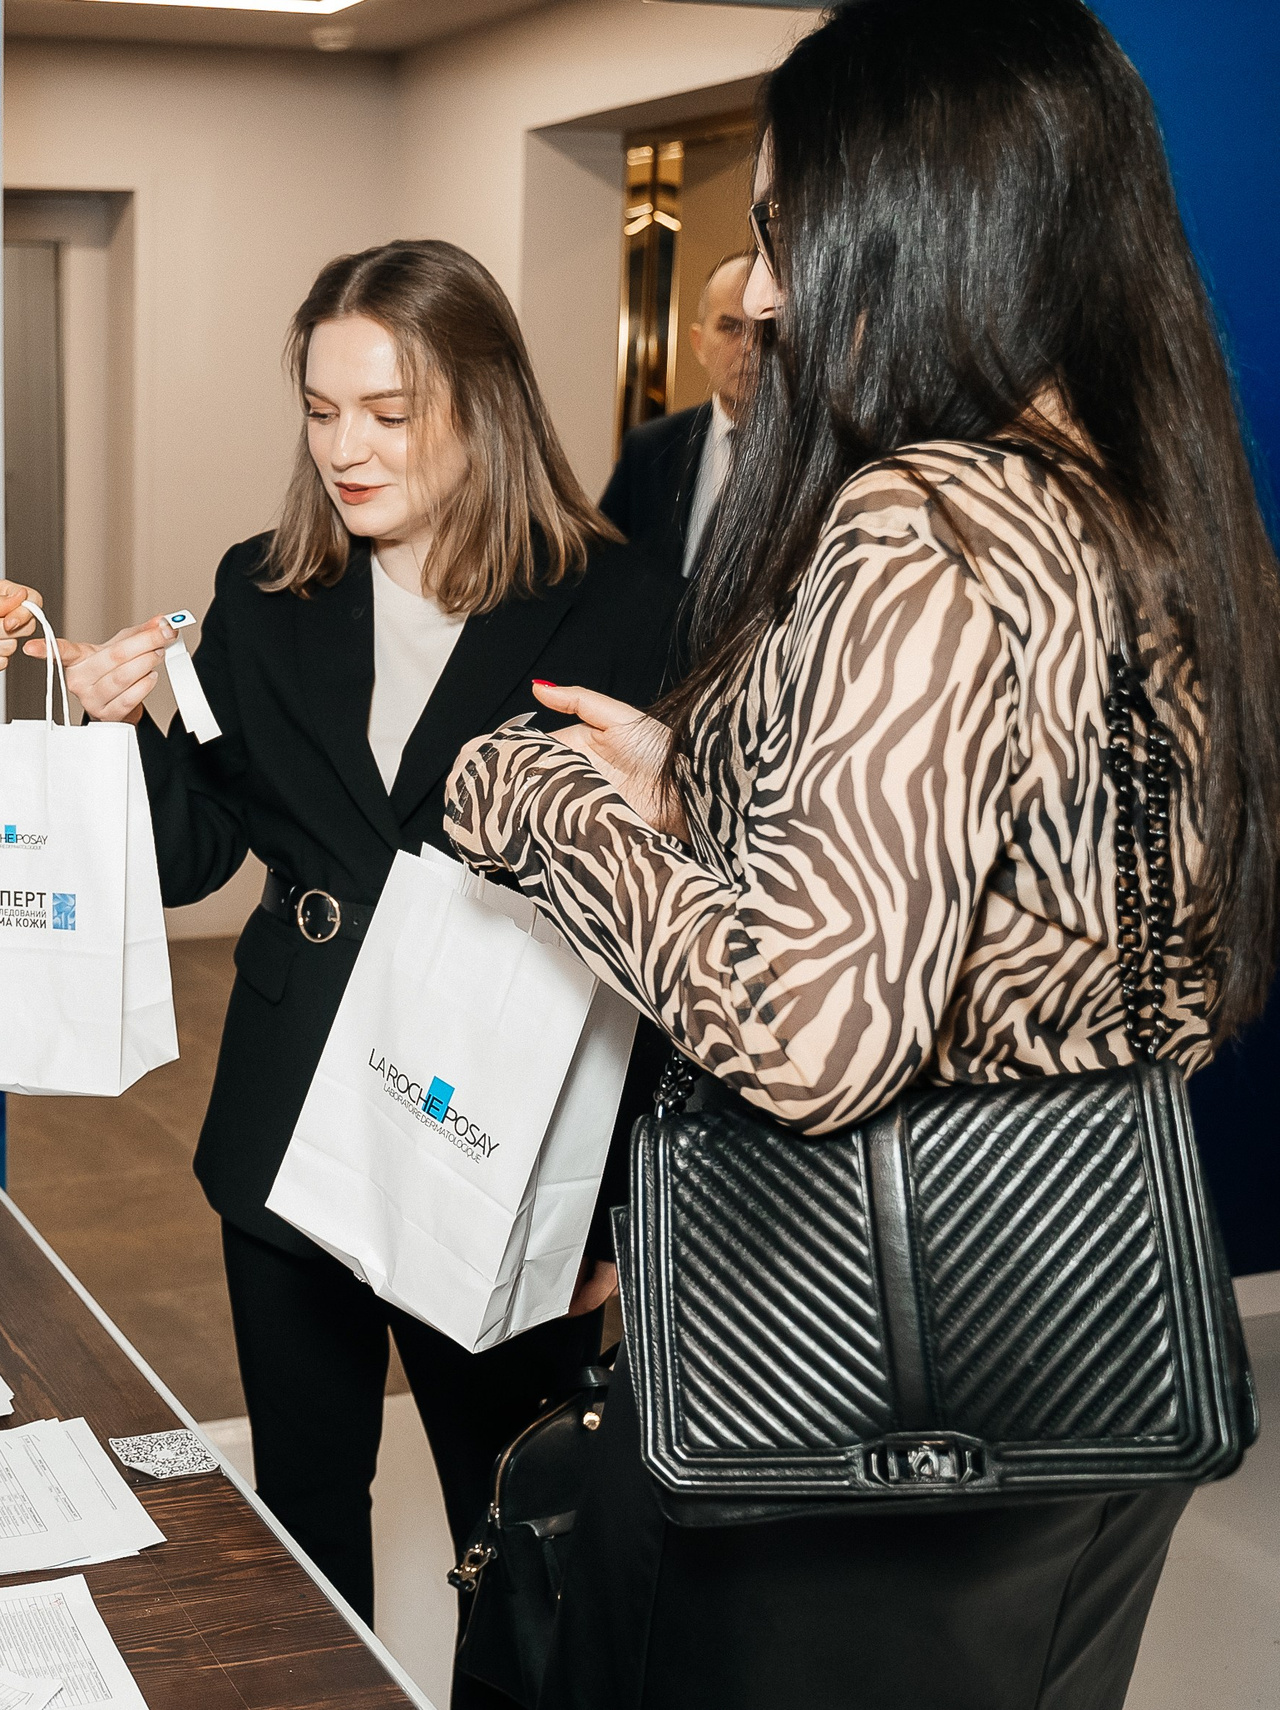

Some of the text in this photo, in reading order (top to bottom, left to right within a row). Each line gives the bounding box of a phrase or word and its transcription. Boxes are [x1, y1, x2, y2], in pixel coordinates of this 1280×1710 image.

[15, 834, 48, 845] POSAY
[15, 917, 47, 929] КОЖИ
[368, 1048, 500, 1158] LA ROCHE POSAY
[382, 1083, 482, 1165] LABORATOIRE DERMATOLOGIQUE
